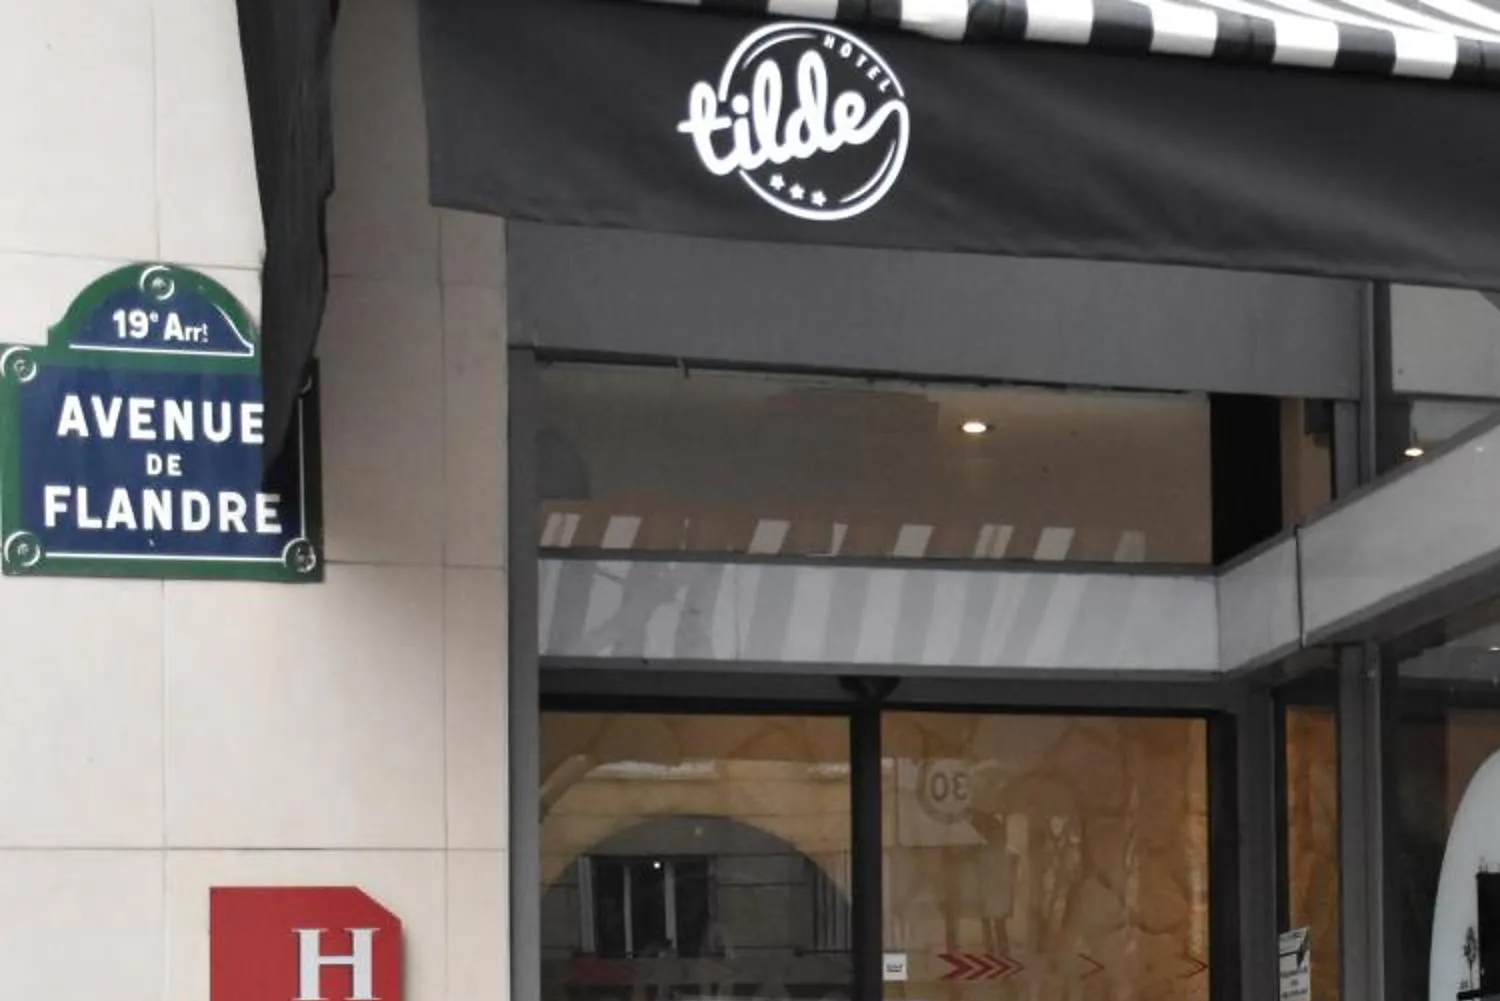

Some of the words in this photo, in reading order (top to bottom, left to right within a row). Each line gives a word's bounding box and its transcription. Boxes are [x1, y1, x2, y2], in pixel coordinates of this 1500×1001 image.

[822, 33, 892, 94] HOTEL
[676, 49, 903, 176] tilde
[56, 394, 265, 445] AVENUE
[146, 453, 183, 478] DE
[43, 484, 284, 534] FLANDRE
